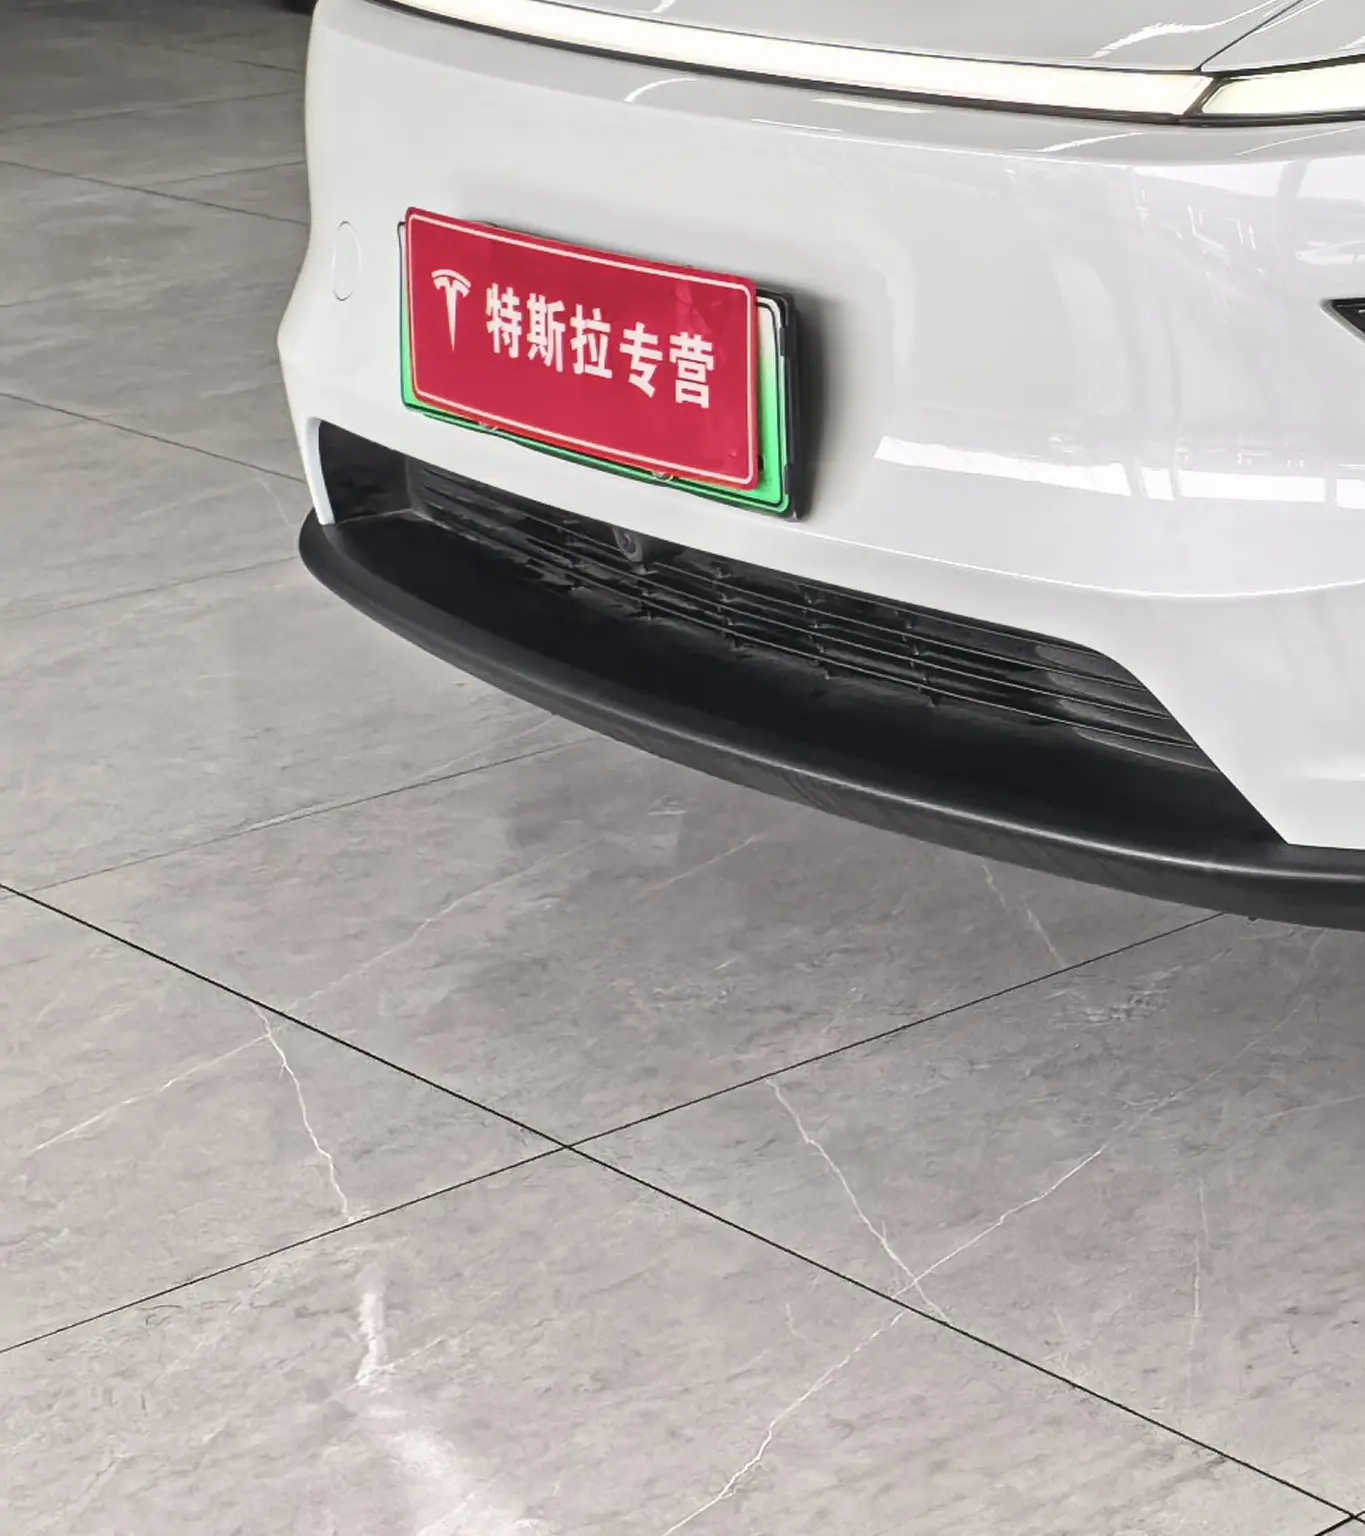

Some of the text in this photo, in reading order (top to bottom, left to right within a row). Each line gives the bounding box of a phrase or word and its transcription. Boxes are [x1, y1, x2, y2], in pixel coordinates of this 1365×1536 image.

[486, 282, 716, 409] 特斯拉专营
